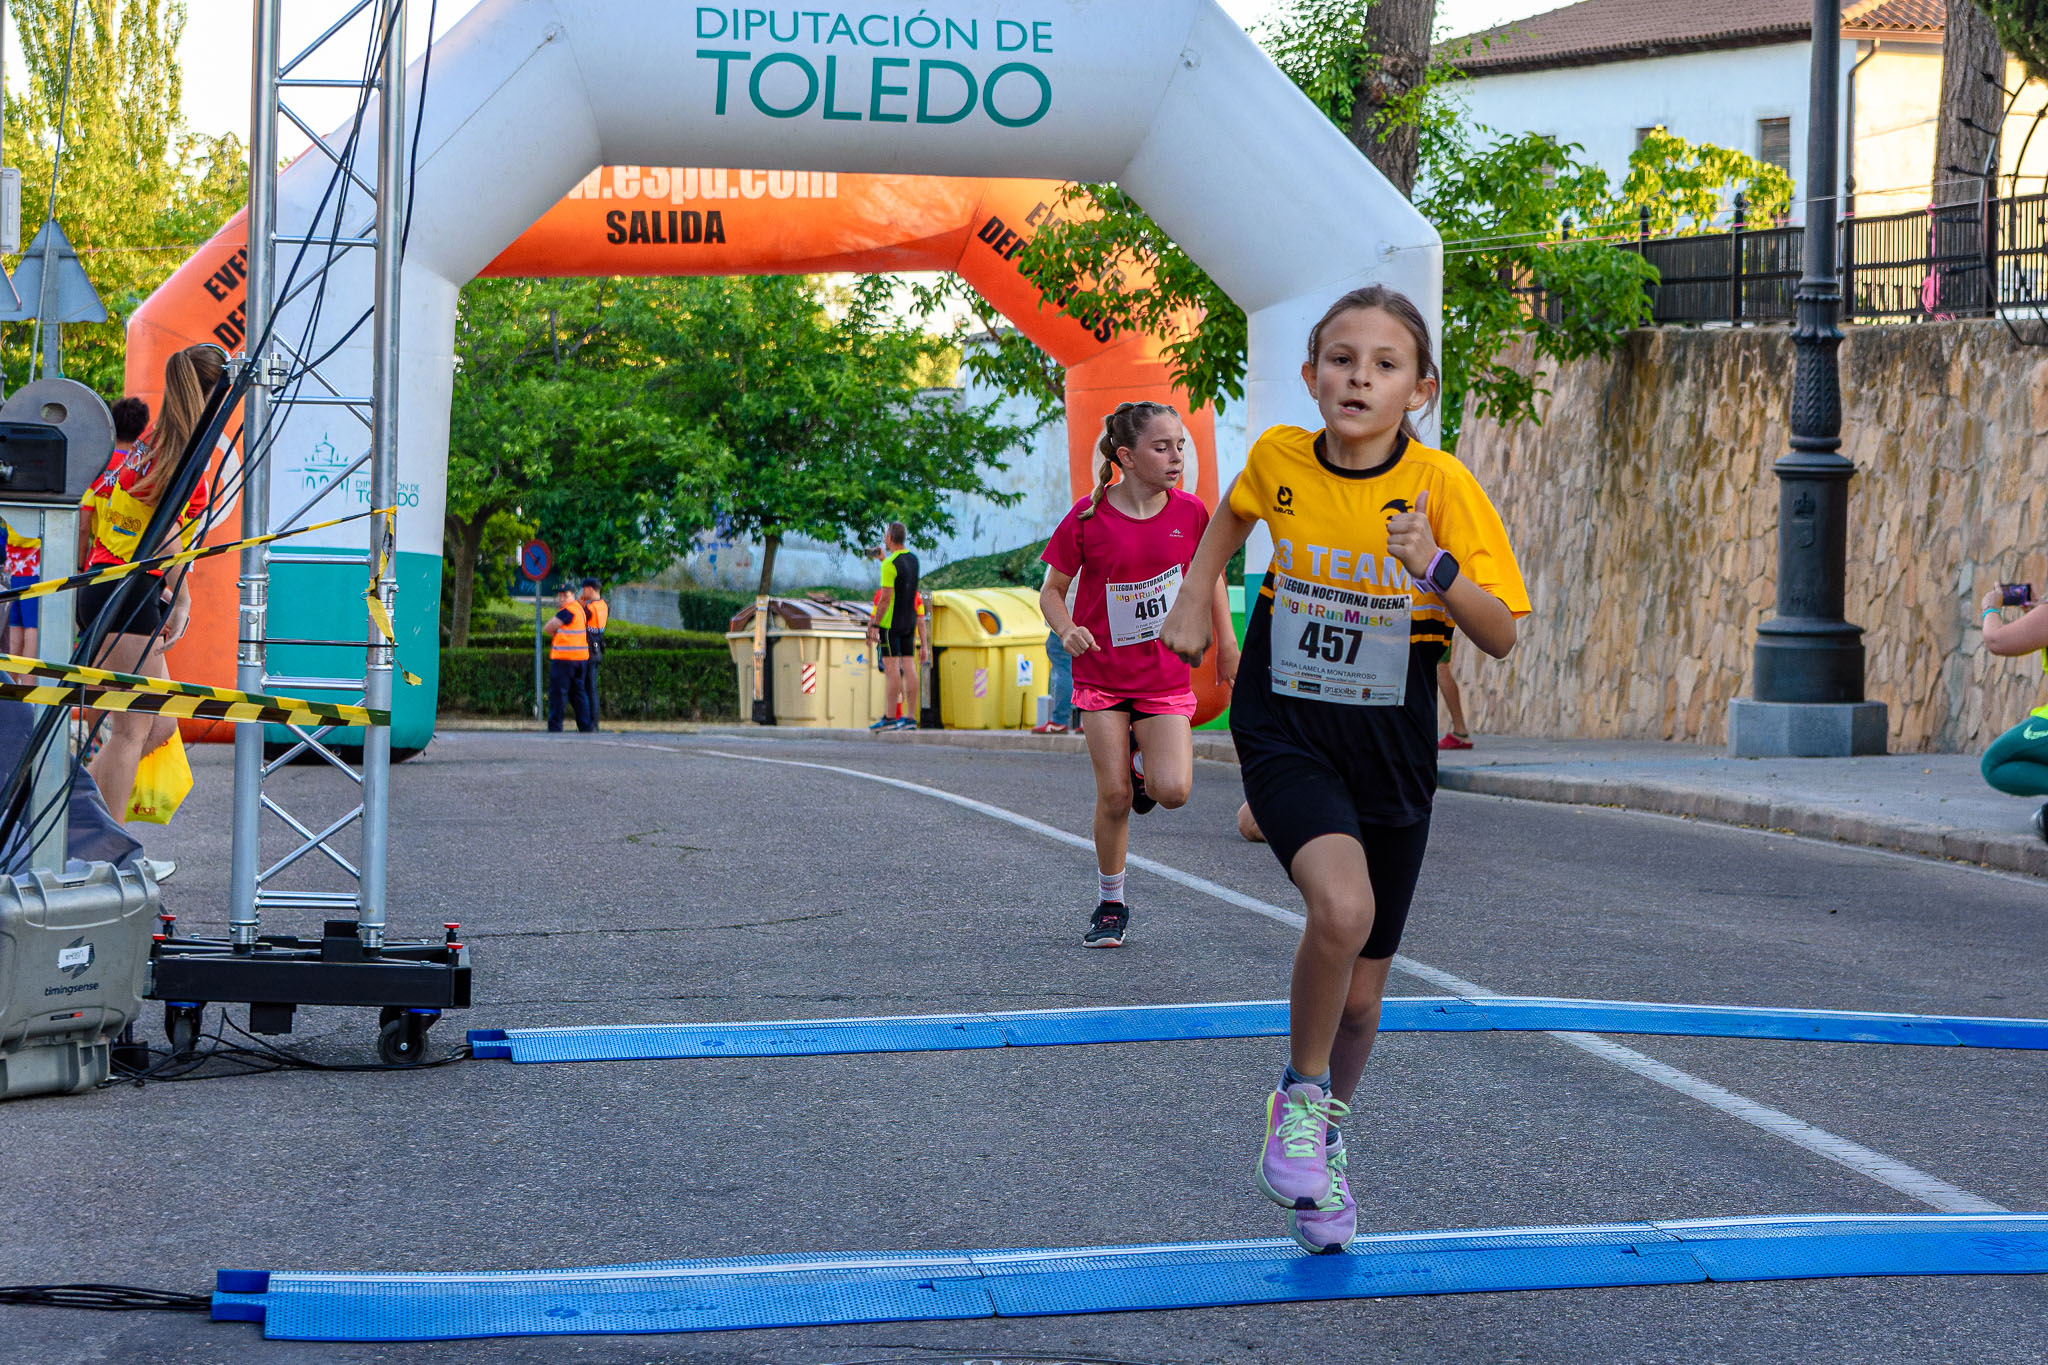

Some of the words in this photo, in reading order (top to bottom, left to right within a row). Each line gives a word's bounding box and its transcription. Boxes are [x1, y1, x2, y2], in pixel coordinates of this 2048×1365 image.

[696, 7, 978, 51] DIPUTACIÓN
[996, 19, 1053, 53] DE
[696, 49, 1052, 127] TOLEDO
[606, 209, 726, 244] SALIDA
[1115, 584, 1134, 592] LEGUA
[1134, 575, 1164, 591] NOCTURNA
[1164, 566, 1179, 580] UGENA
[1307, 544, 1413, 591] TEAM
[1135, 593, 1168, 620] 461
[1284, 578, 1311, 596] LEGUA
[1311, 585, 1368, 608] NOCTURNA
[1370, 597, 1405, 610] UGENA
[1298, 621, 1363, 665] 457
[1298, 663, 1326, 674] LAMELA
[1326, 667, 1377, 680] MONTARROSO
[44, 981, 99, 997] timingsense
